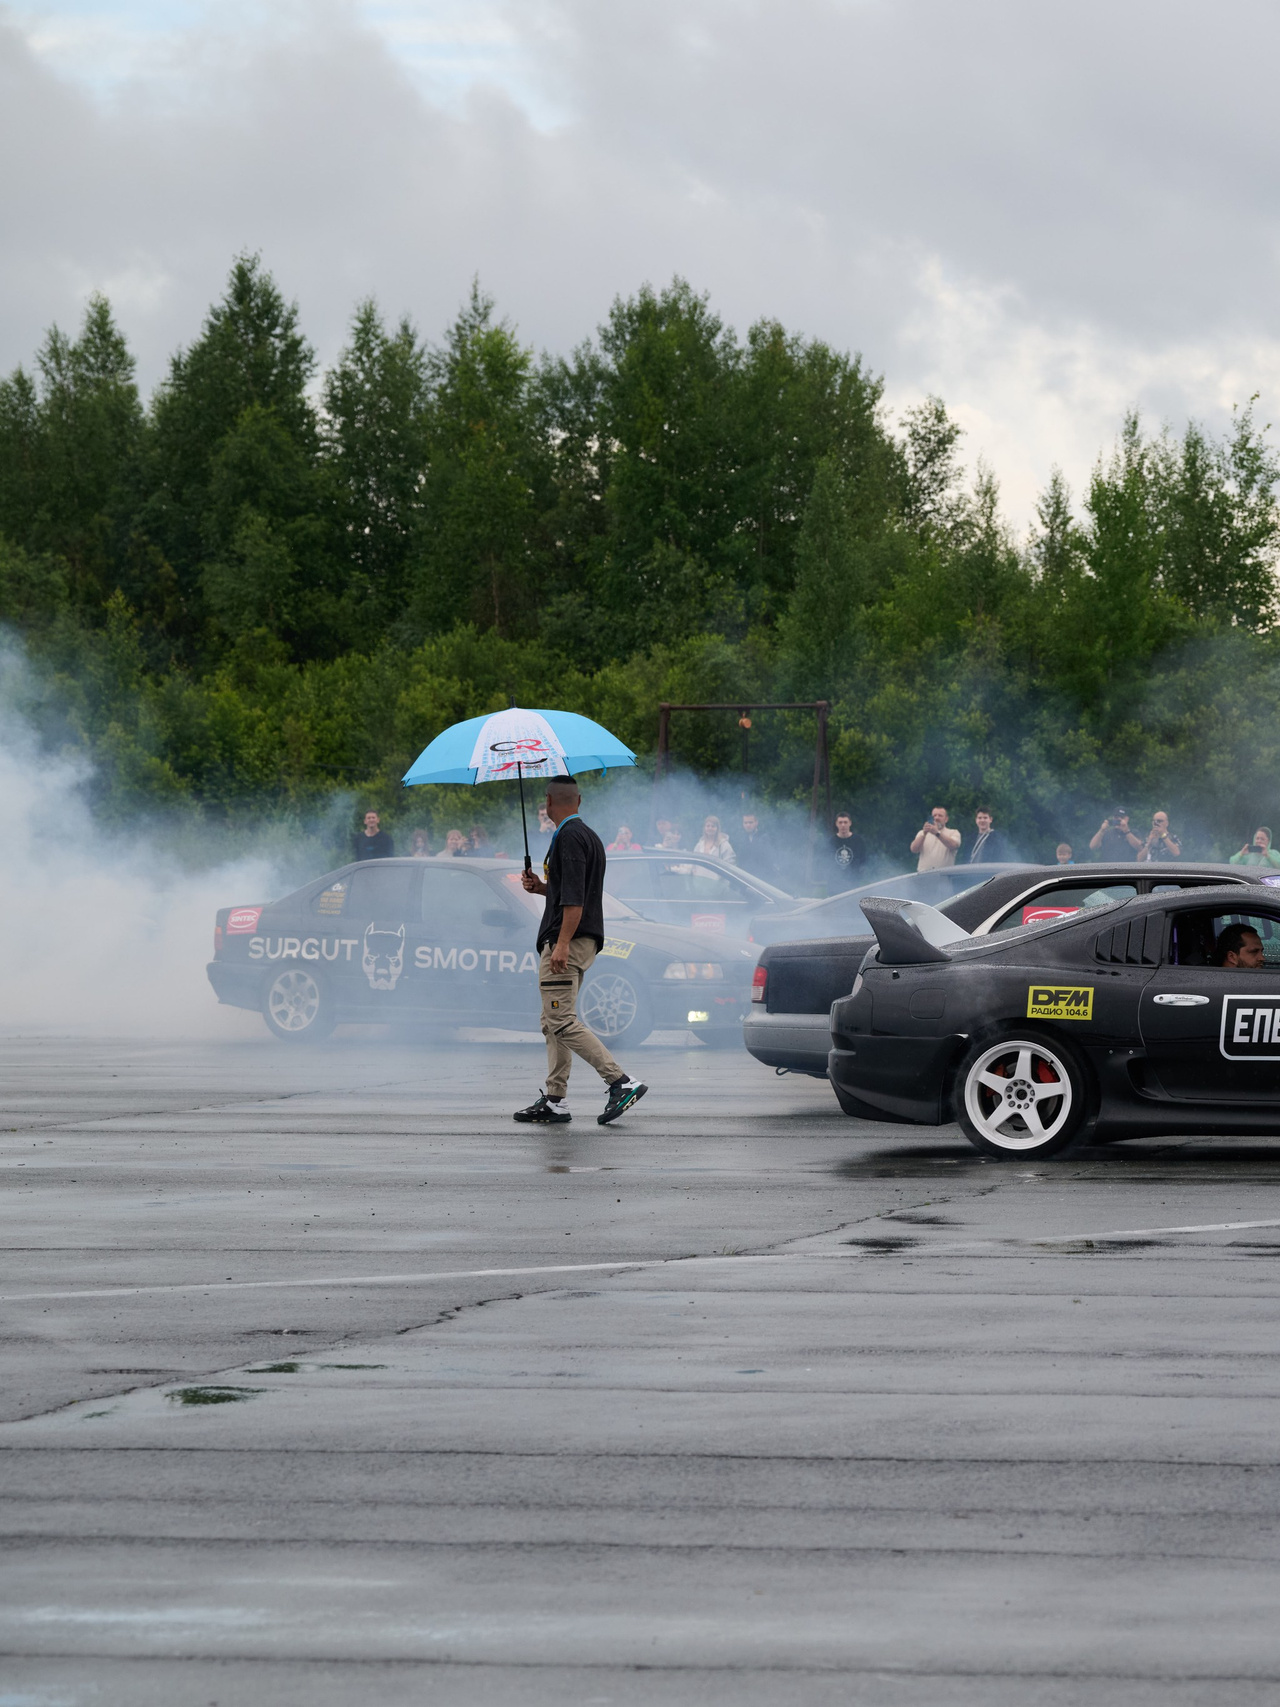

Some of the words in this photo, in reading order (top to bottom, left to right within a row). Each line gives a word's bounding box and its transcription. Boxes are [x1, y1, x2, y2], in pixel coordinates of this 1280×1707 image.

[231, 915, 256, 923] SINTEC
[249, 937, 359, 961] SURGUT
[1032, 990, 1089, 1007] DFM
[1031, 1008, 1063, 1016] РАДИО
